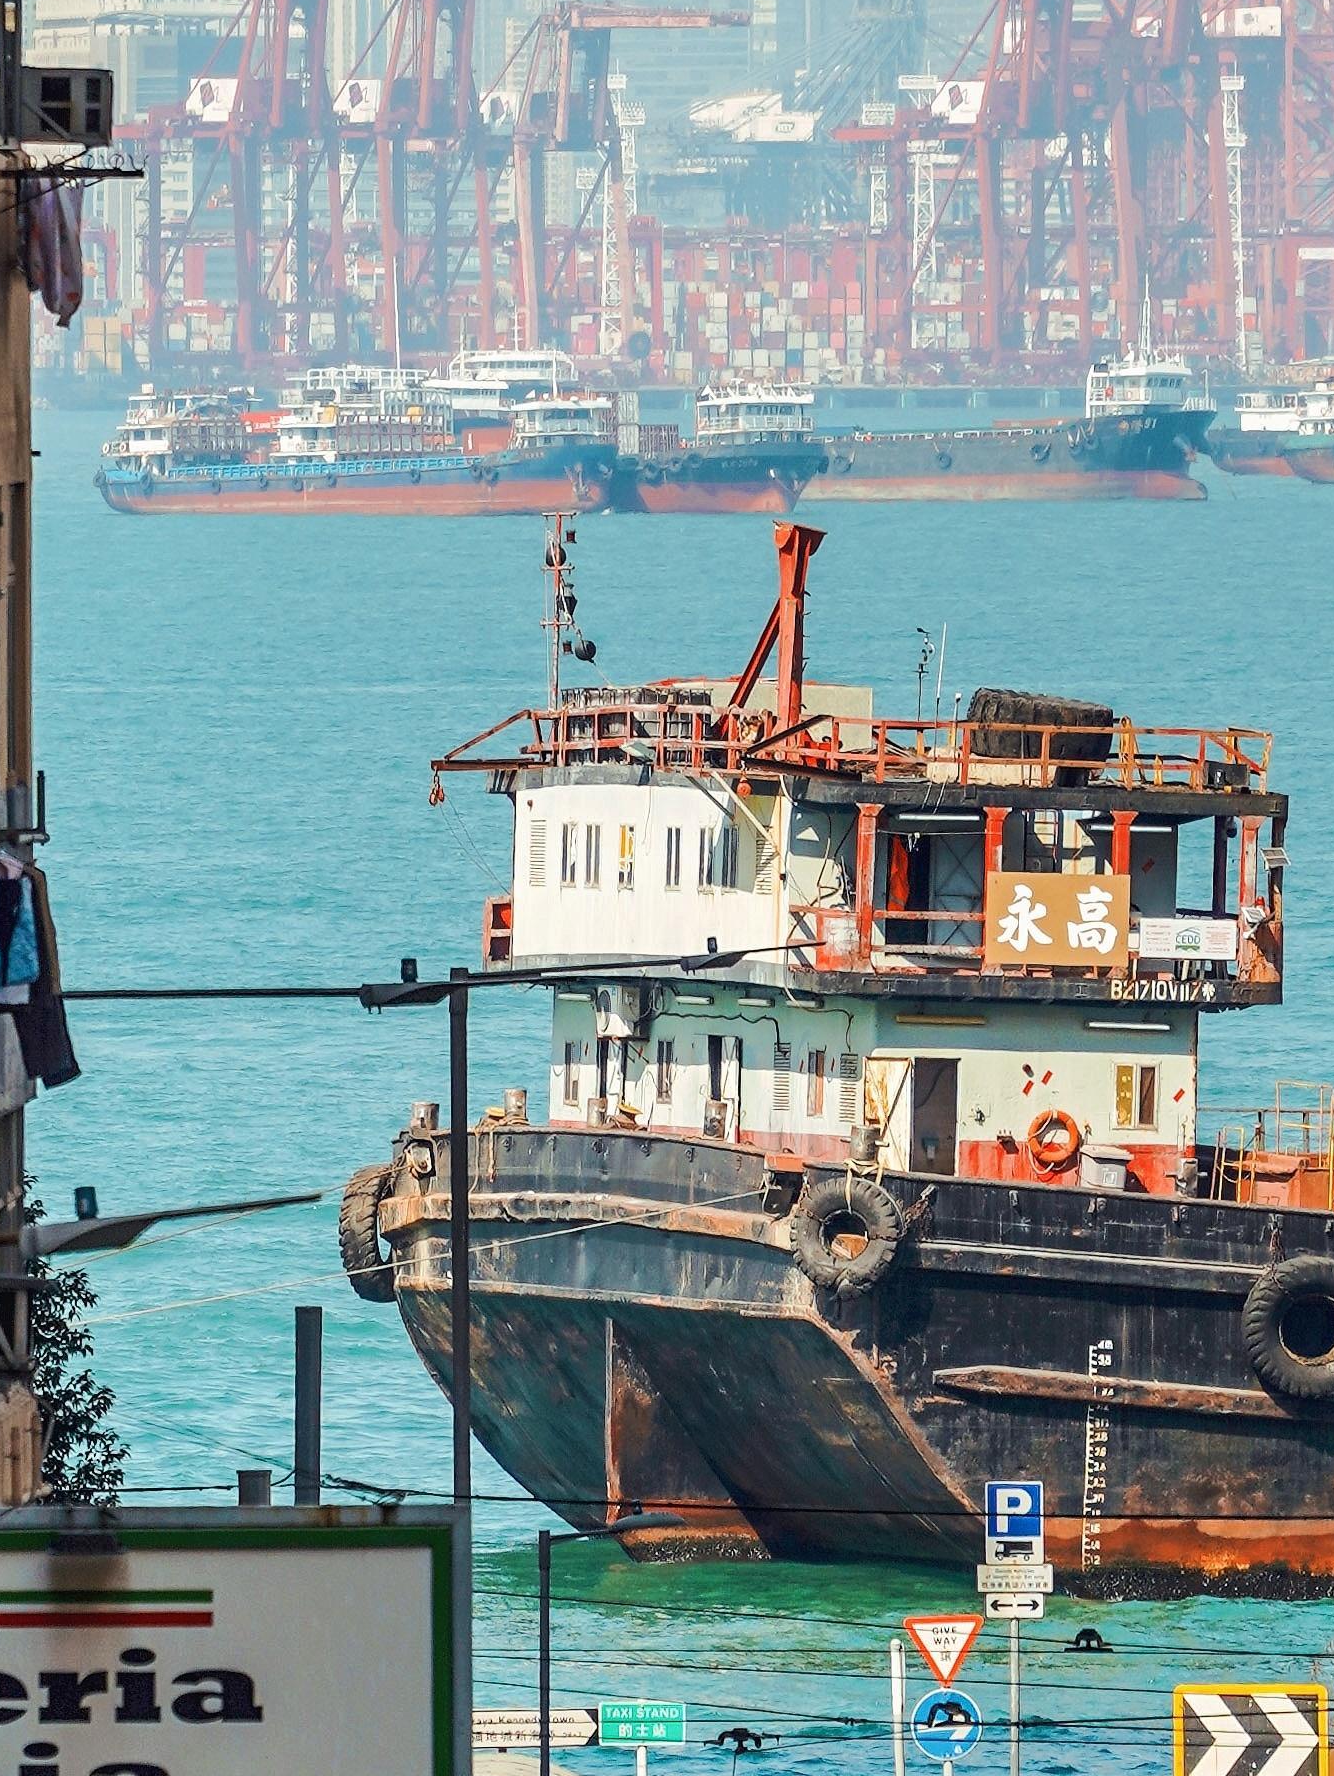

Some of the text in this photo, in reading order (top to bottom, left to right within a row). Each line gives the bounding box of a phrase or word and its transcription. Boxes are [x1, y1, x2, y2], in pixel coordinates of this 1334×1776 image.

[996, 884, 1118, 953] 永高
[1175, 934, 1201, 944] CEDD
[997, 1488, 1032, 1533] P
[932, 1626, 957, 1635] GIVE
[934, 1637, 957, 1645] WAY
[605, 1706, 680, 1719] TAXI STAND
[472, 1718, 492, 1727] aya
[618, 1724, 667, 1737] 的士站
